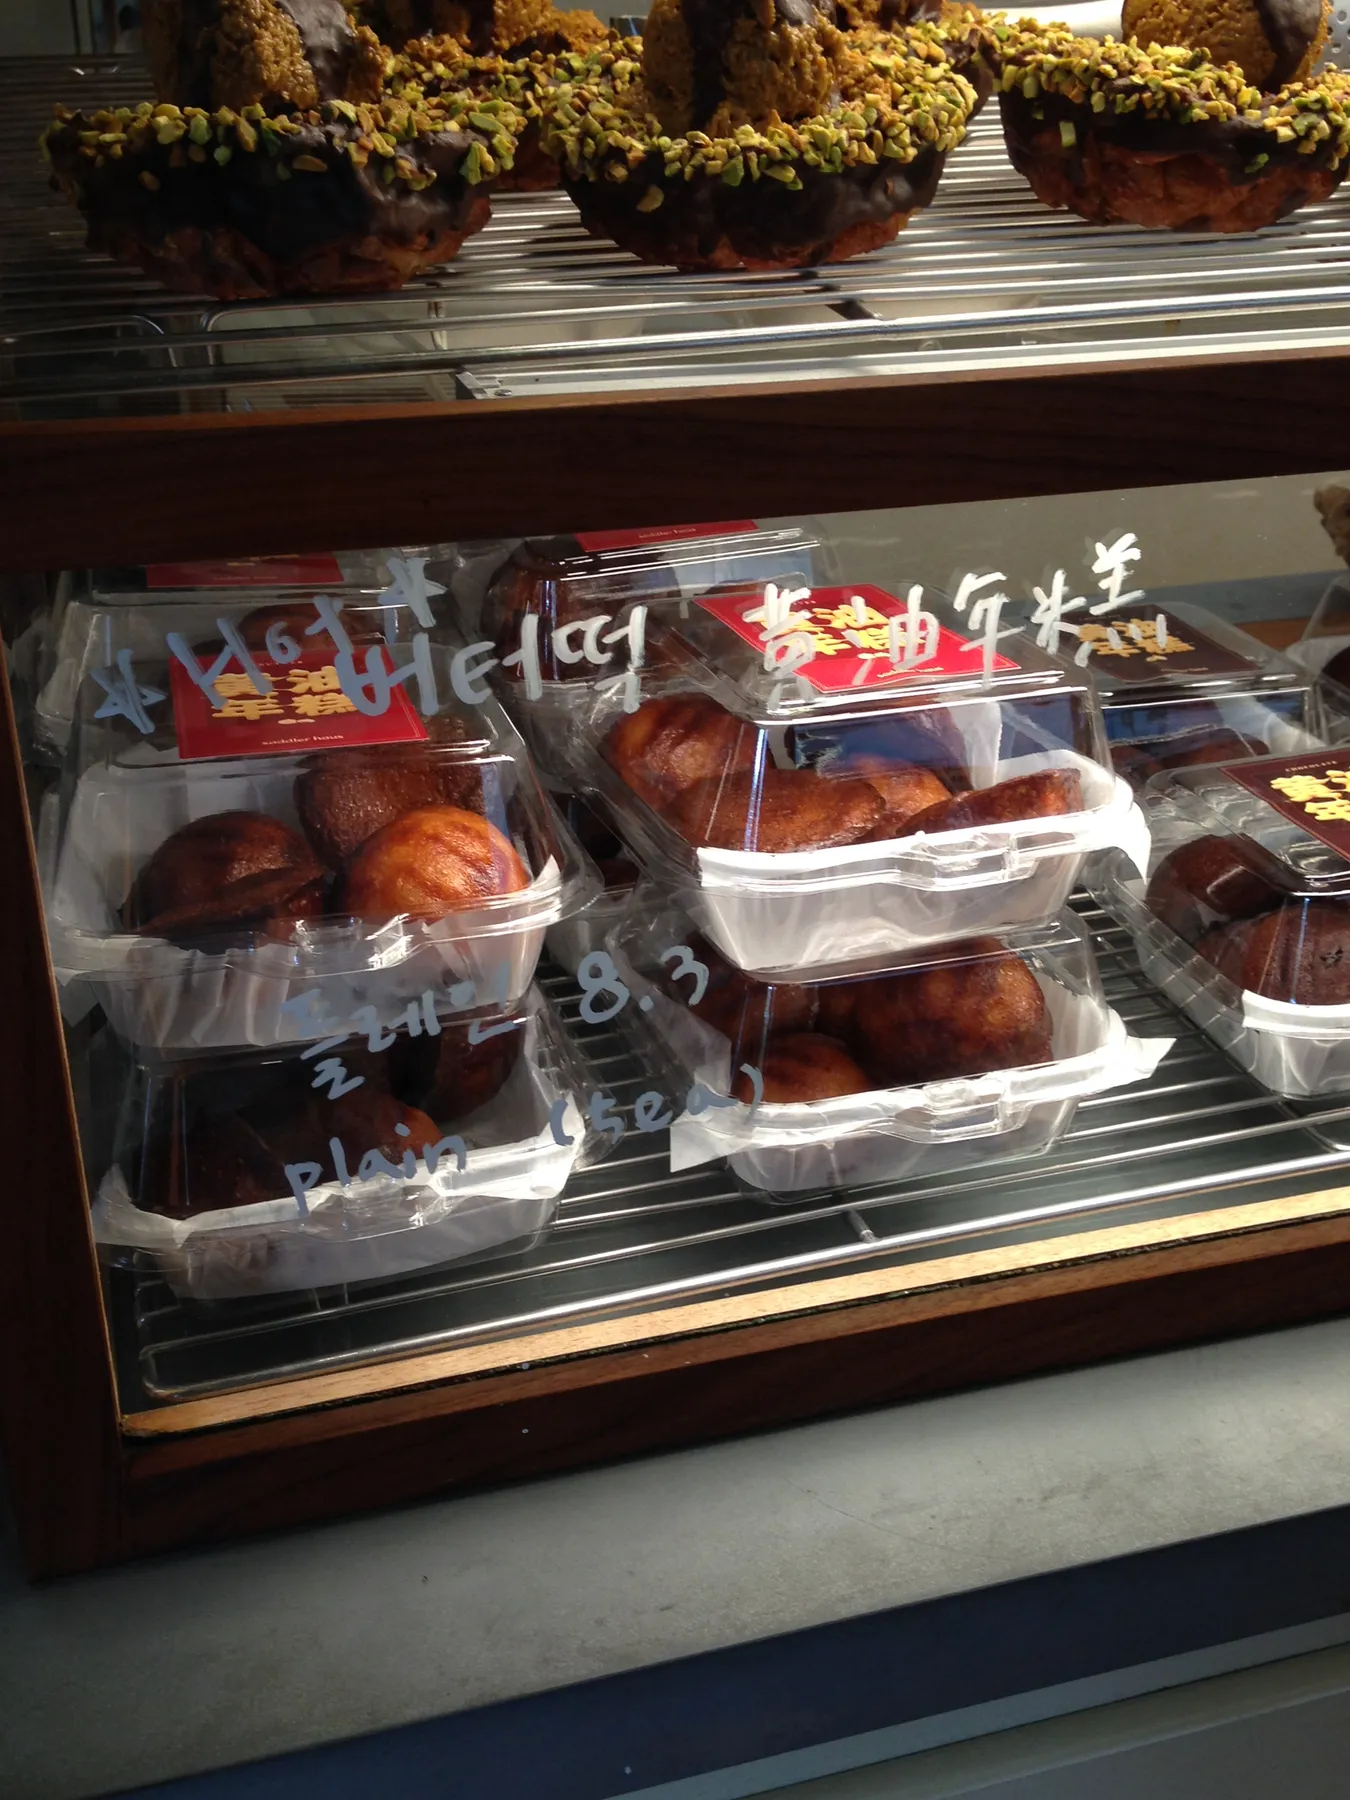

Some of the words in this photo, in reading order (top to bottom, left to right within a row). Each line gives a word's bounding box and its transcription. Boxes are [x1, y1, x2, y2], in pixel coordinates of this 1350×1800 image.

[166, 593, 354, 710] Hot
[334, 605, 649, 717] 버터떡
[312, 733, 345, 742] haus
[575, 944, 710, 1024] 8.3
[283, 1122, 468, 1218] plain
